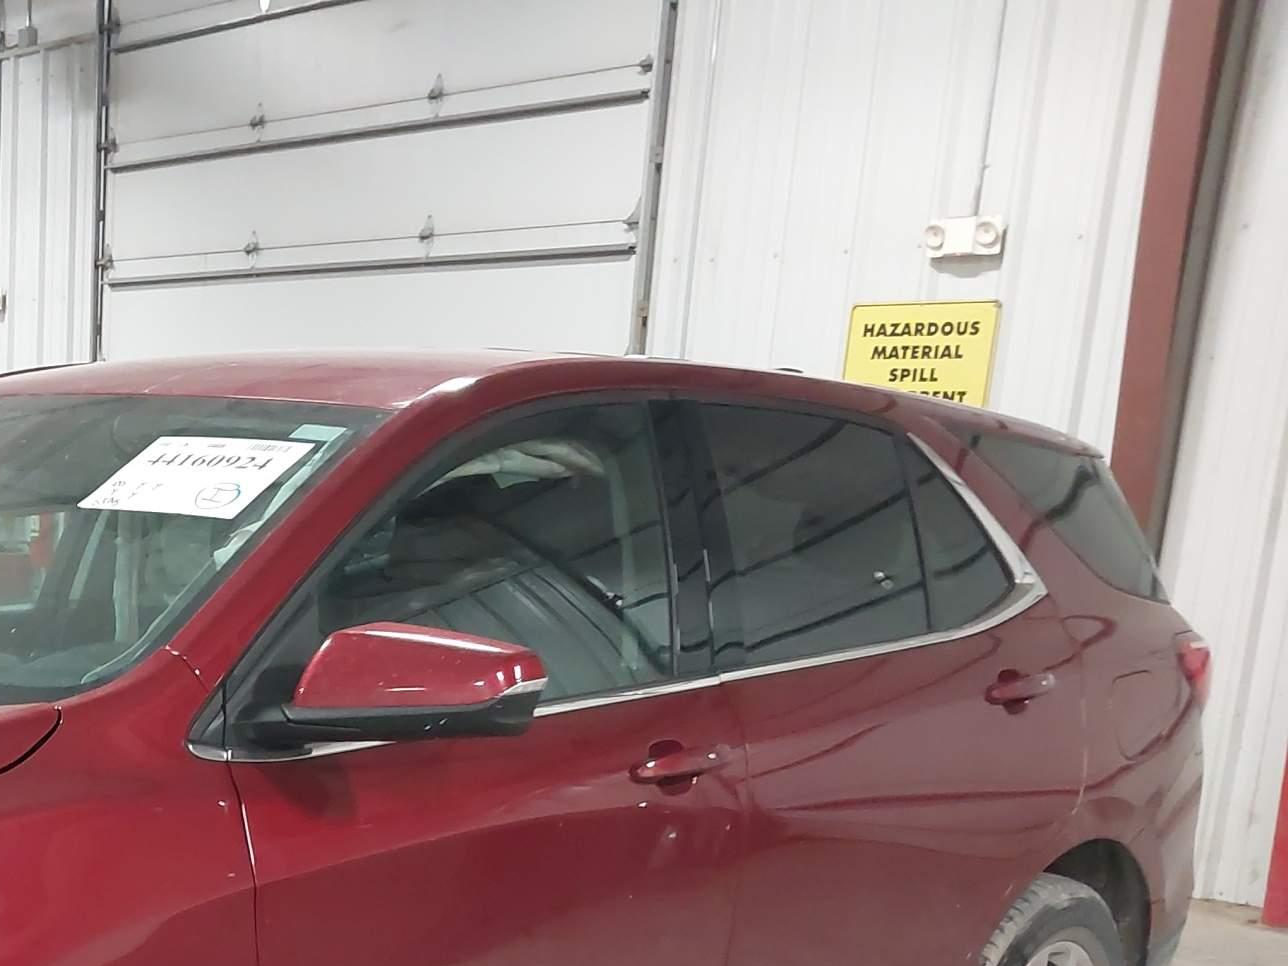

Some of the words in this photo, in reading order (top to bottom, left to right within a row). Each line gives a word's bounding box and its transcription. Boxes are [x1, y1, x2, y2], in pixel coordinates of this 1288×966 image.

[863, 321, 980, 338] HAZARDOUS
[870, 345, 964, 361] MATERIAL
[888, 367, 939, 383] SPILL
[147, 453, 273, 470] 44160924
